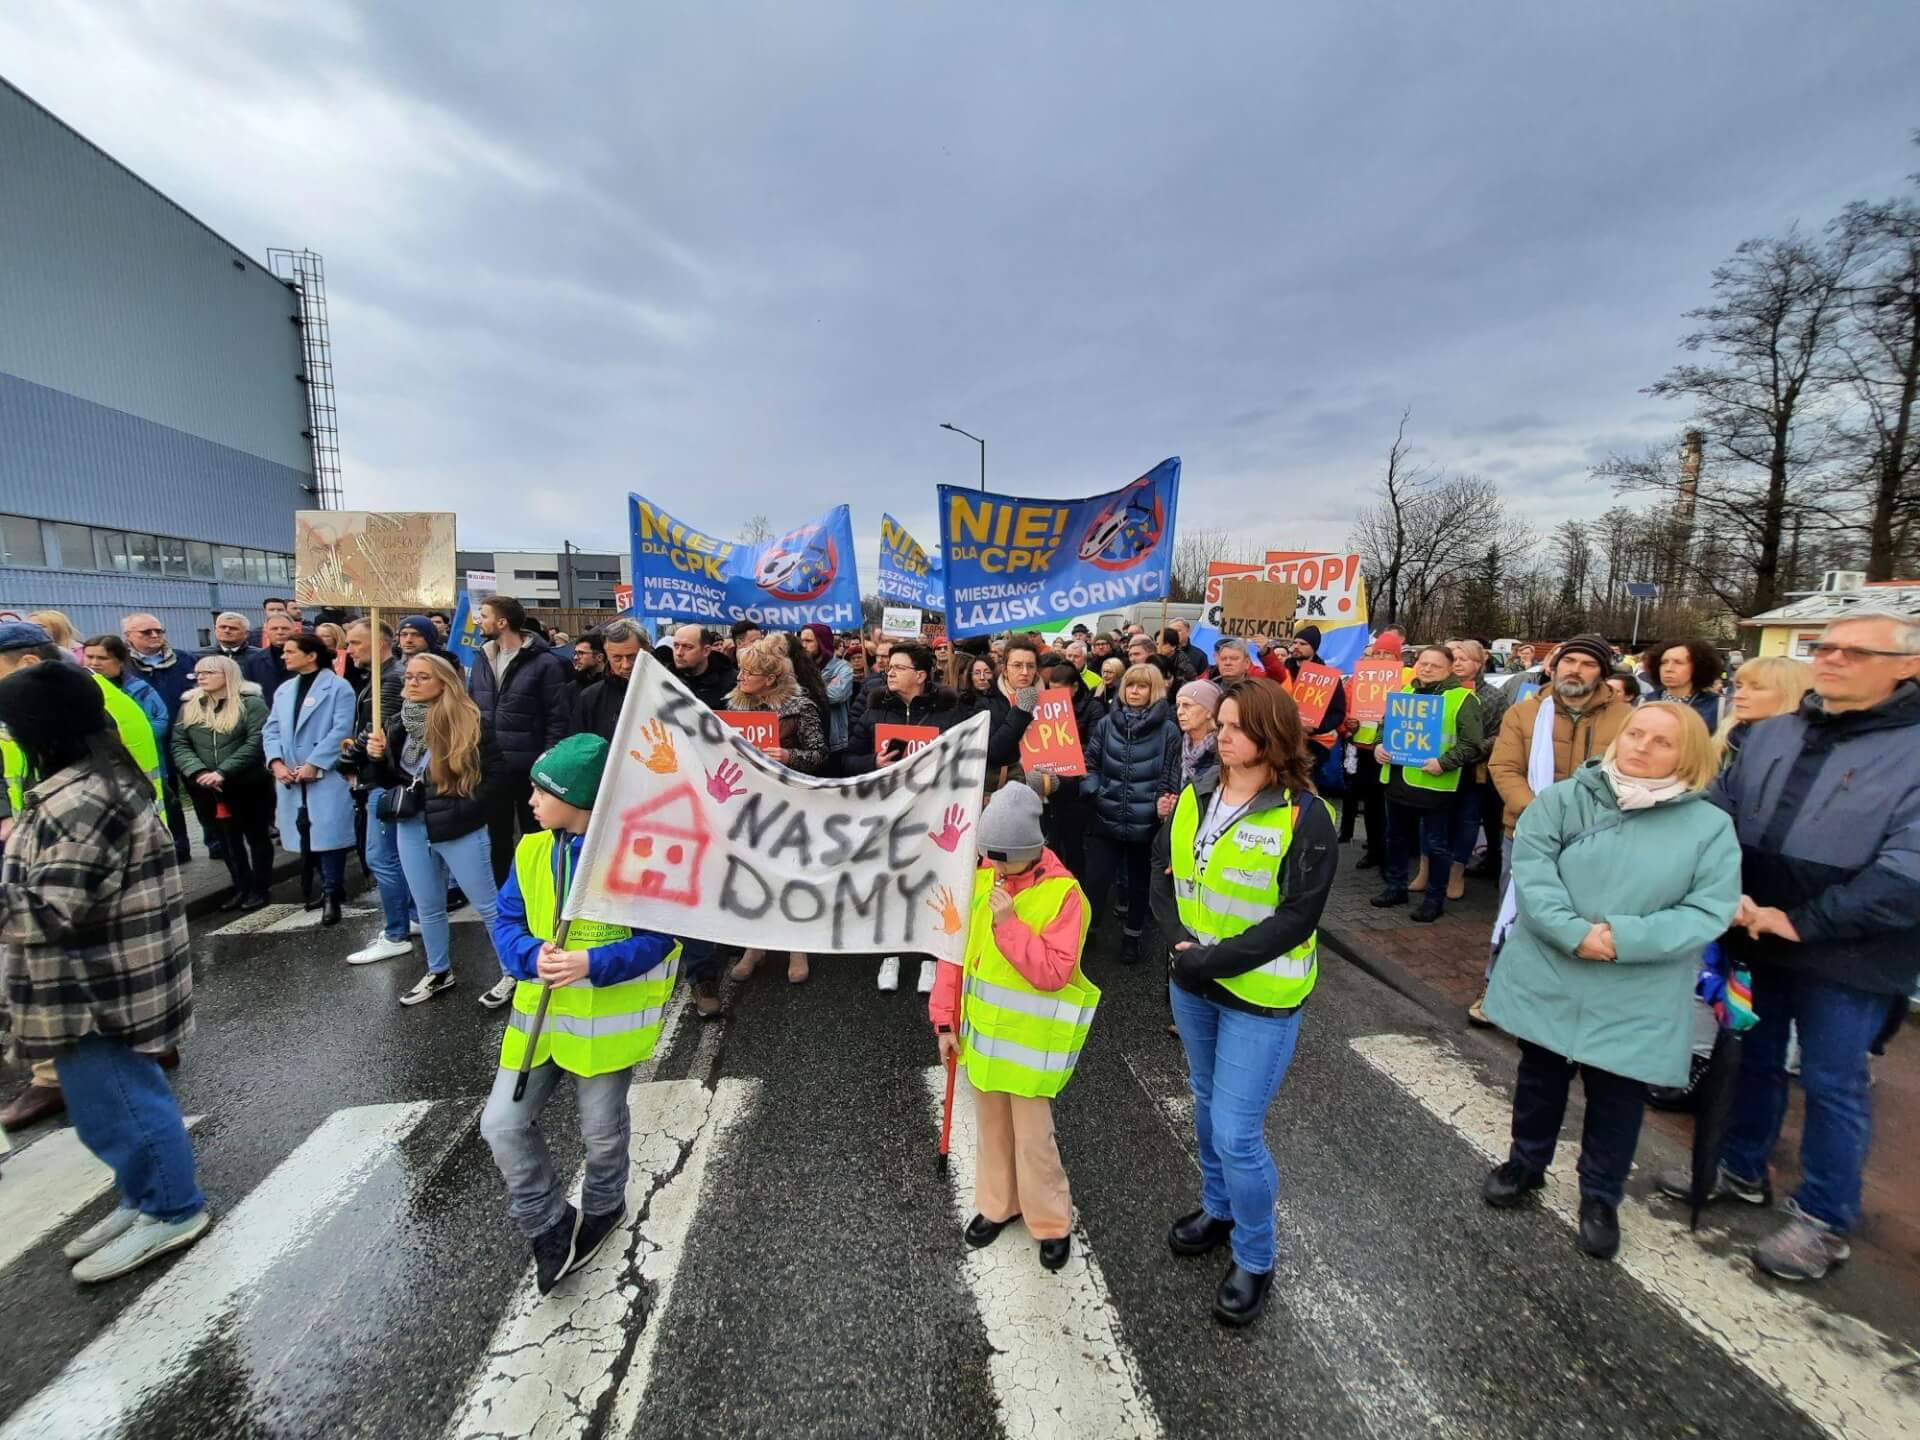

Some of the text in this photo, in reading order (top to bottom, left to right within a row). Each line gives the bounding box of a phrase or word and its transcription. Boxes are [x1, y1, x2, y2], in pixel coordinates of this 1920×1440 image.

[639, 501, 732, 559] NIE!
[950, 495, 1069, 548] NIE!
[642, 542, 730, 584] DLA CPK
[952, 546, 1056, 573] DLA CPK
[644, 576, 727, 601] MIESZKAŃCY
[878, 579, 921, 602] AZISK
[954, 579, 1047, 603] MIESZKAŃCY
[1267, 554, 1361, 612] STOP!
[643, 591, 853, 625] ŁAZISK GÓRNYCH
[955, 595, 1046, 630] ŁAZISK
[1299, 671, 1335, 687] STOP!
[1357, 669, 1399, 682] STOP!
[1292, 684, 1328, 708] CPK
[1032, 699, 1069, 721] TOP!
[1391, 698, 1437, 720] NIE!
[738, 725, 772, 743] OP!
[1022, 721, 1074, 753] CPK
[1391, 729, 1431, 751] CPK
[728, 793, 930, 871] NASZE
[1237, 831, 1276, 846] MEDIA
[719, 854, 937, 949] DOMY
